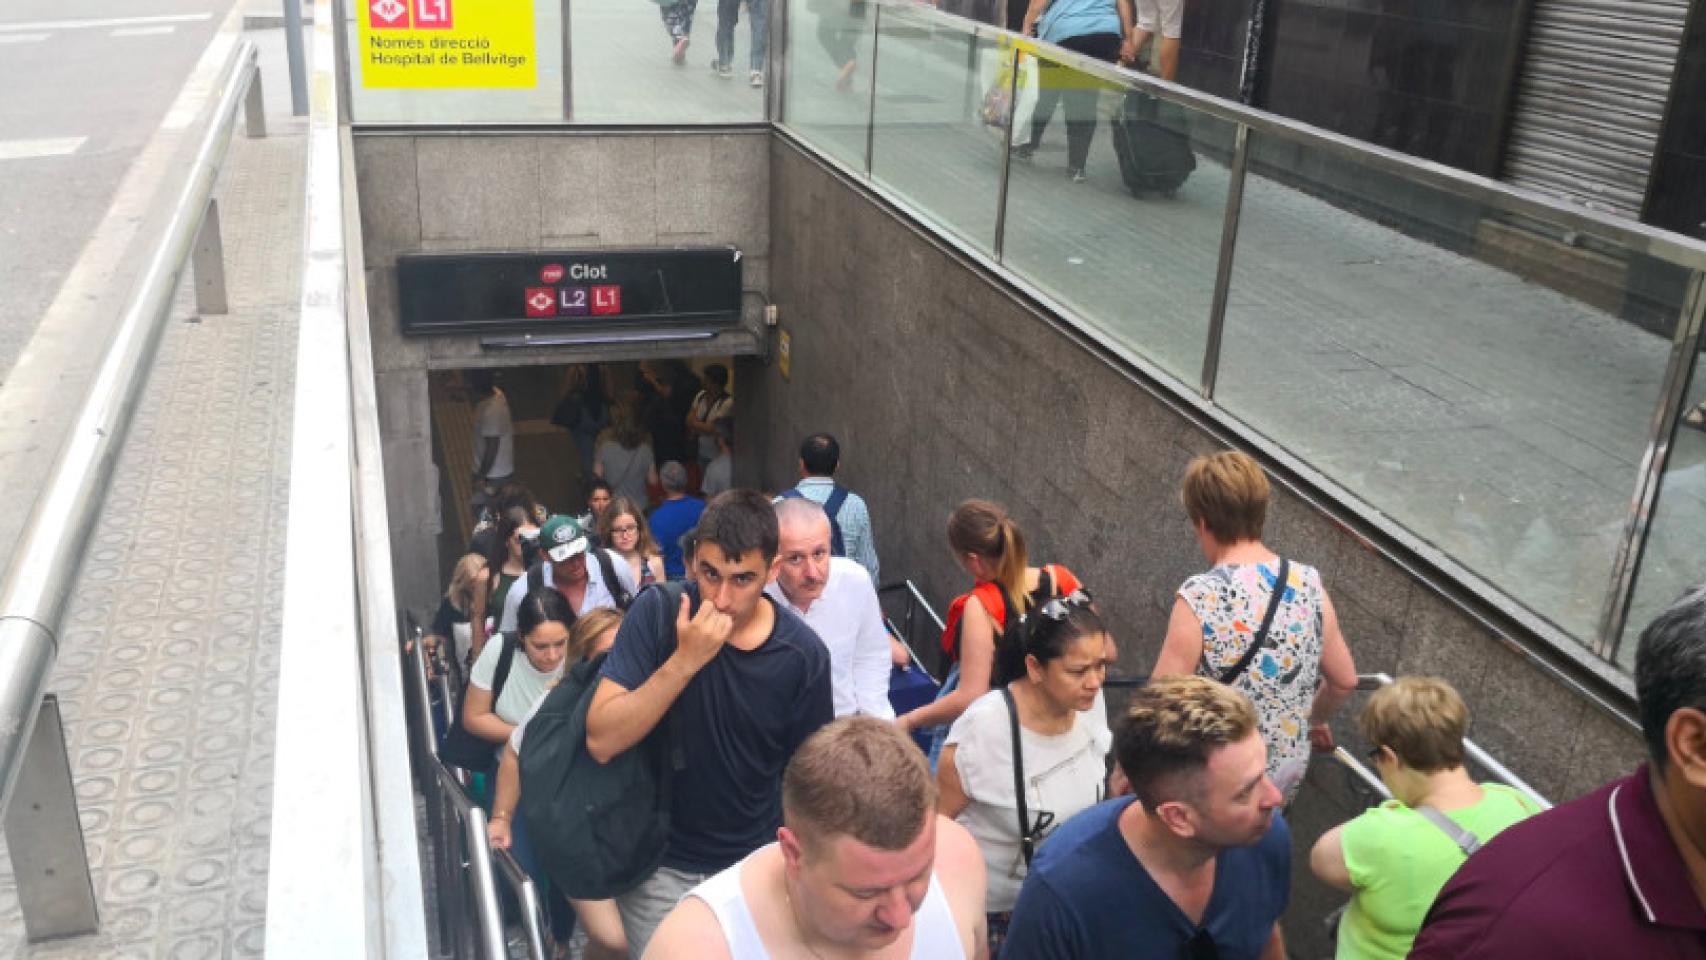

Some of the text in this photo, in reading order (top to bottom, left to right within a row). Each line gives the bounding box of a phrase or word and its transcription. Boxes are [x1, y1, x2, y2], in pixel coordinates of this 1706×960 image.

[419, 0, 446, 21] L1
[371, 35, 490, 49] Només direcció
[371, 52, 526, 67] Hospital de Bellvitge
[570, 264, 608, 279] Clot
[561, 289, 616, 306] L2 L1
